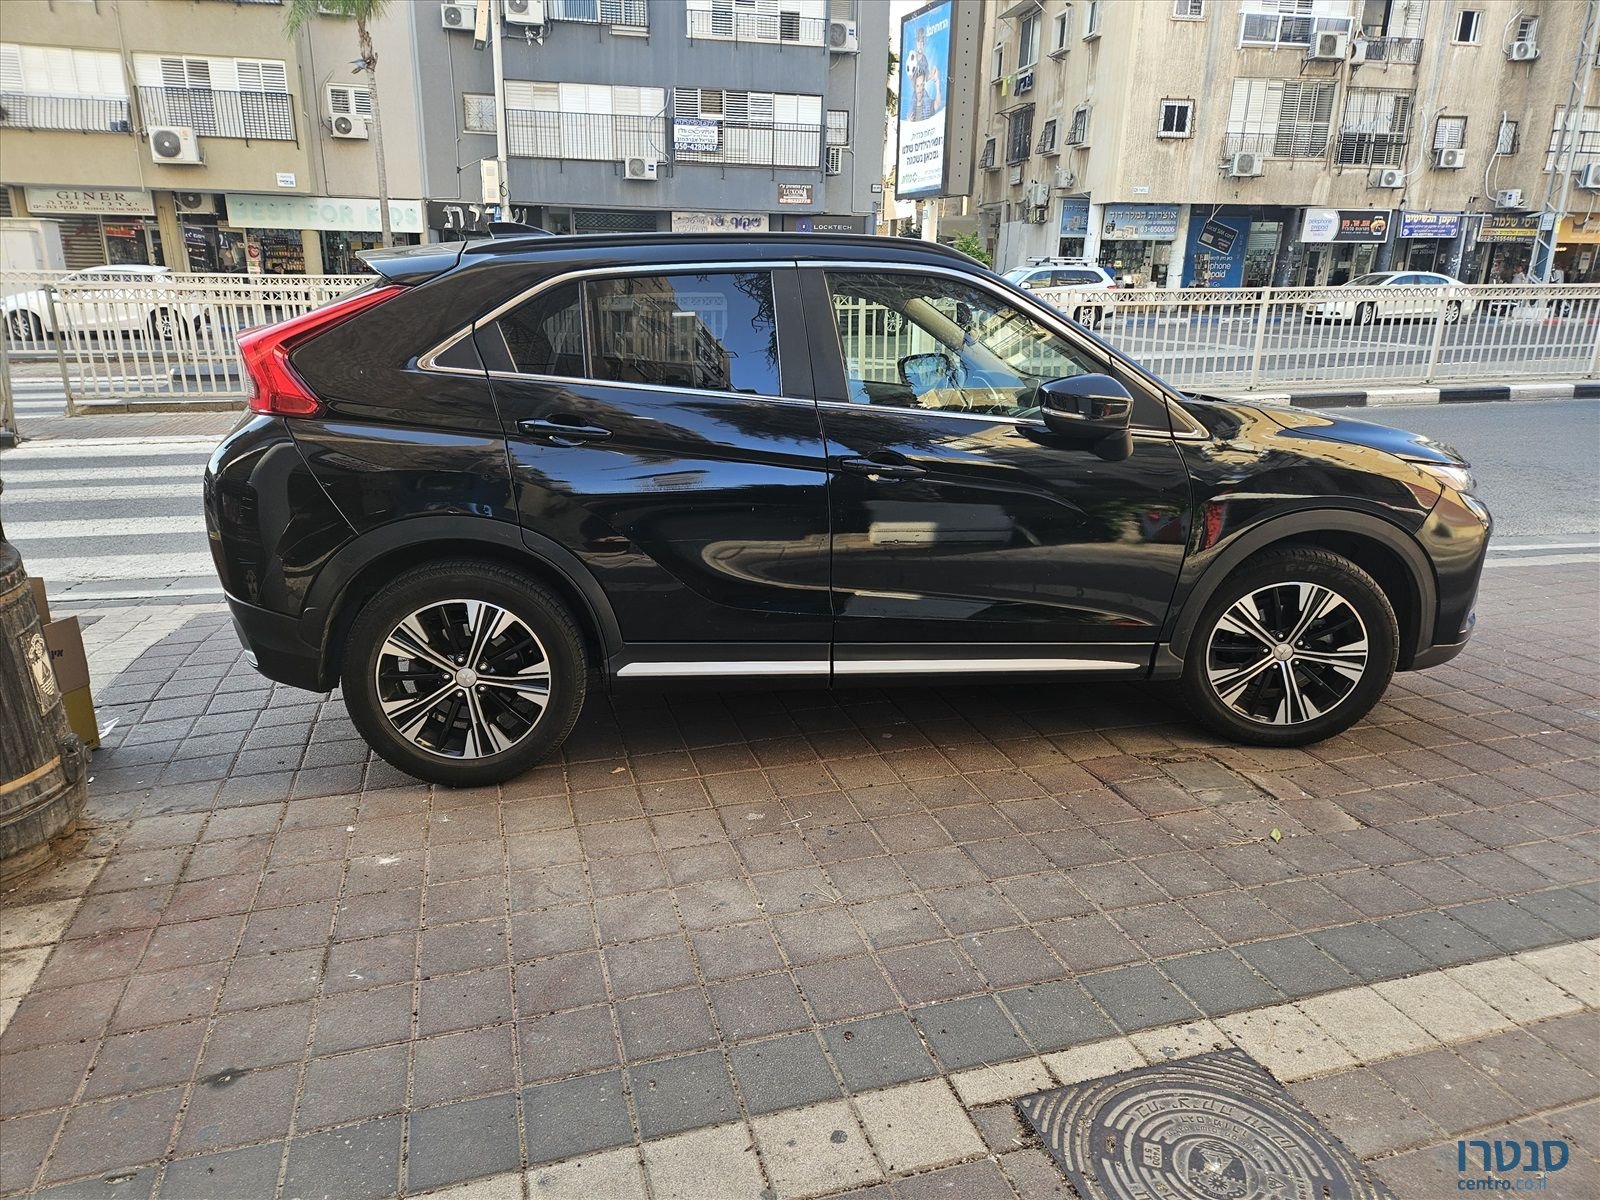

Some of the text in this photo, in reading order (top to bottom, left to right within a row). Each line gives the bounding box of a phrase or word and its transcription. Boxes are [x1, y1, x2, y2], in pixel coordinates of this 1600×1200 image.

[56, 191, 127, 202] GINER
[232, 200, 418, 227] BEST FOR KDS
